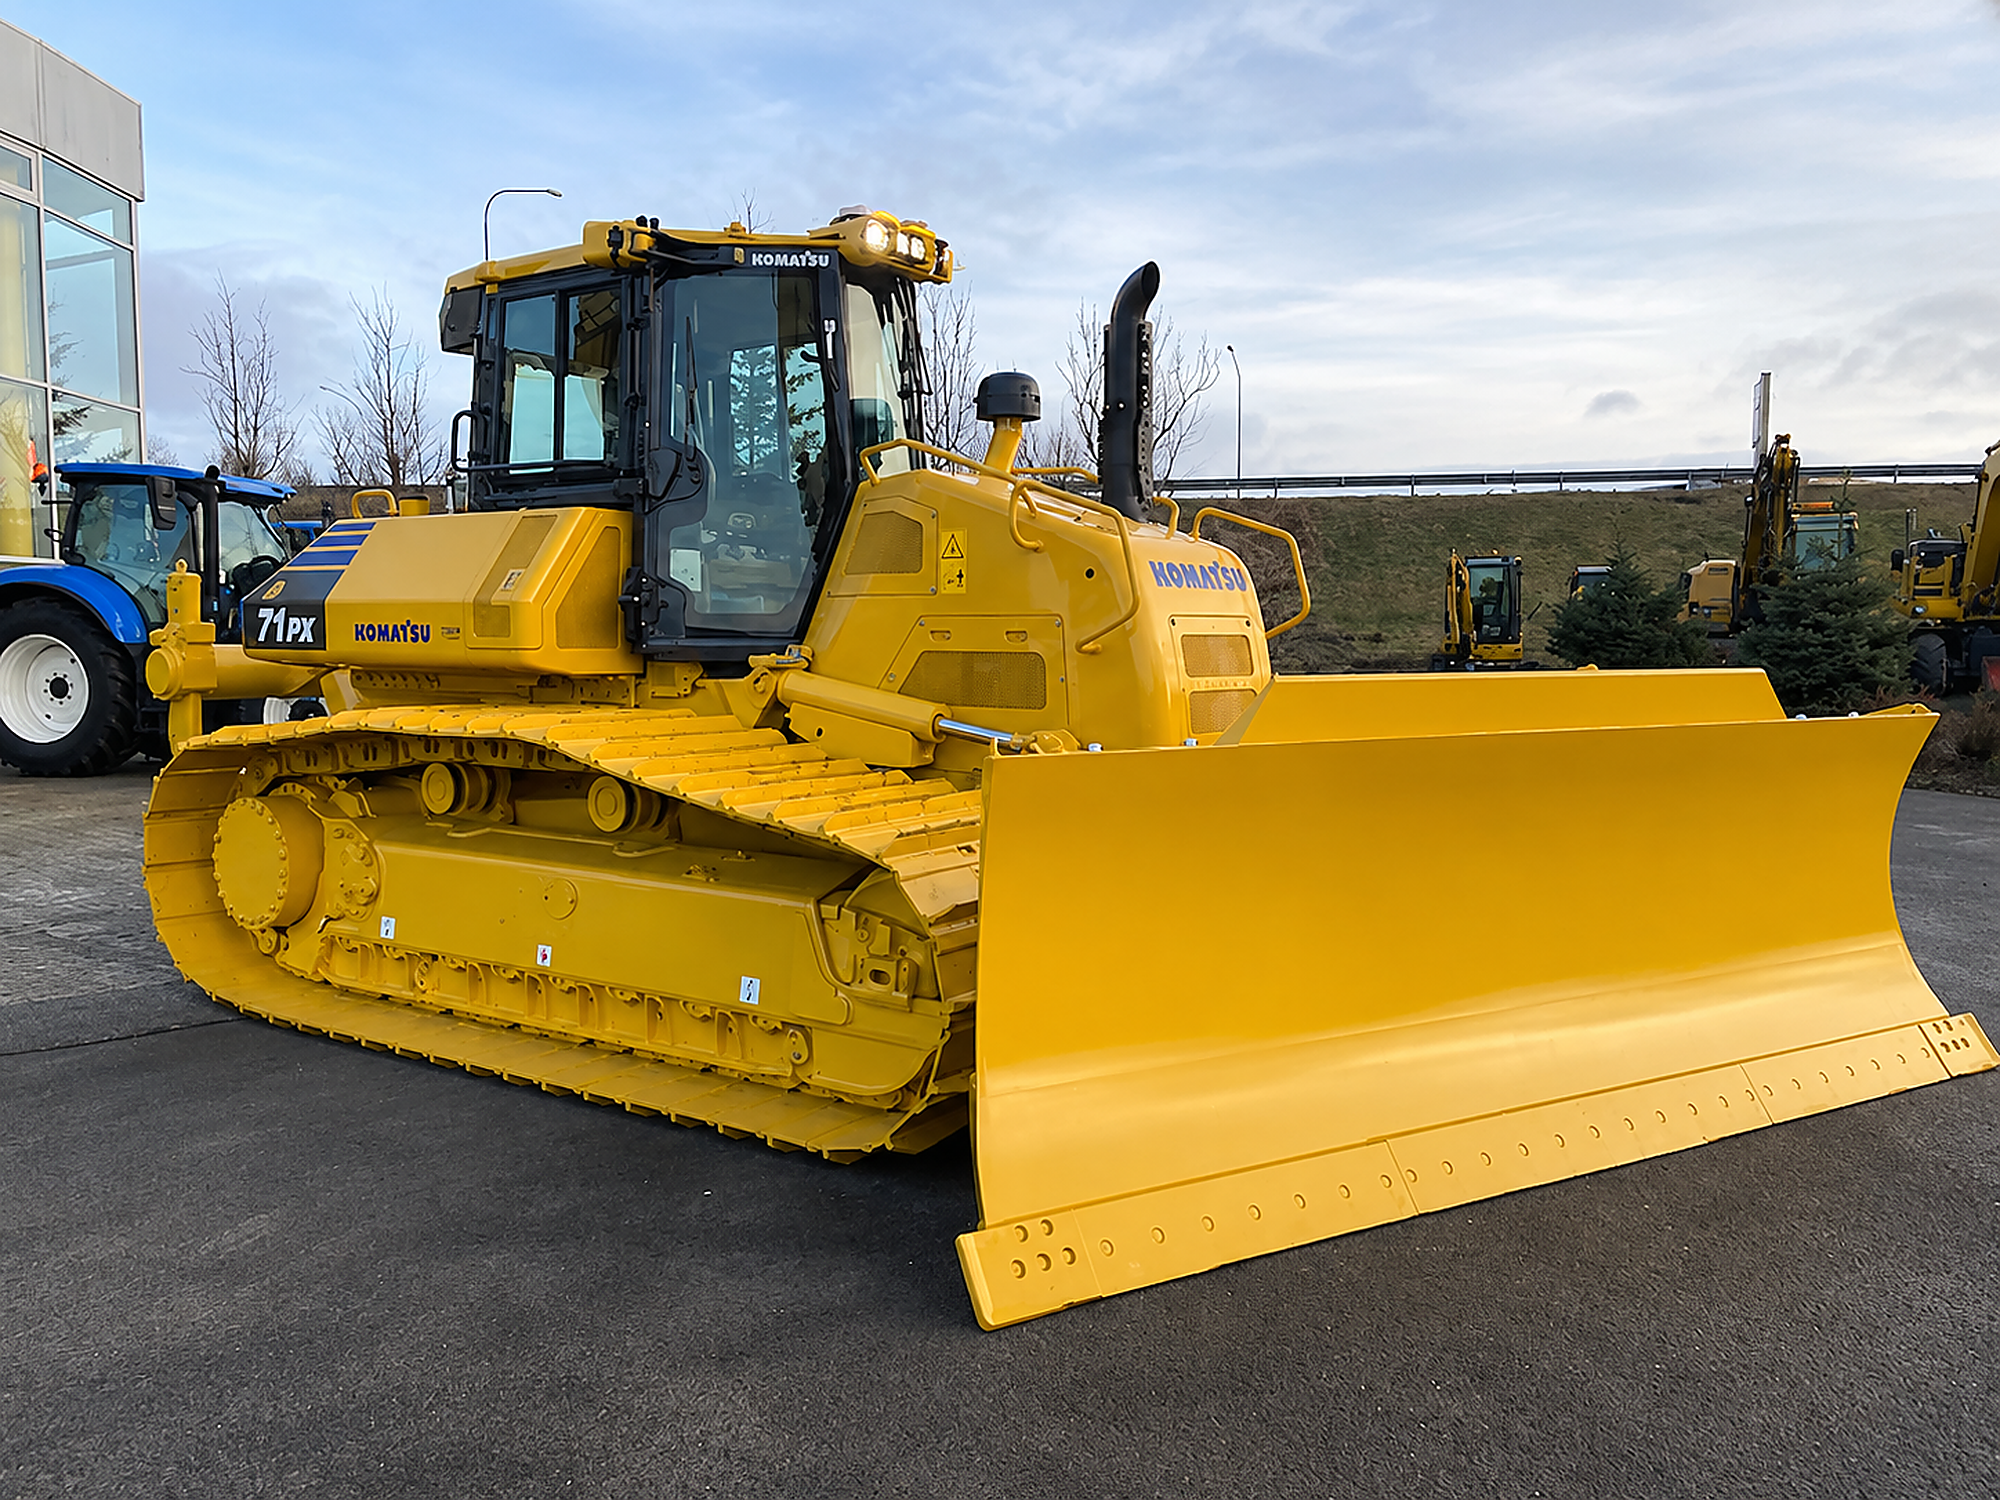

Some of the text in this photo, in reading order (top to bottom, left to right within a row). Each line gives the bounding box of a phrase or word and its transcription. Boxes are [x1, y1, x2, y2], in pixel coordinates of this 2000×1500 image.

[751, 250, 830, 267] KOMATSU
[1148, 560, 1247, 592] KOMATSU
[257, 606, 317, 643] 71PX
[354, 619, 431, 643] KOMATSU
